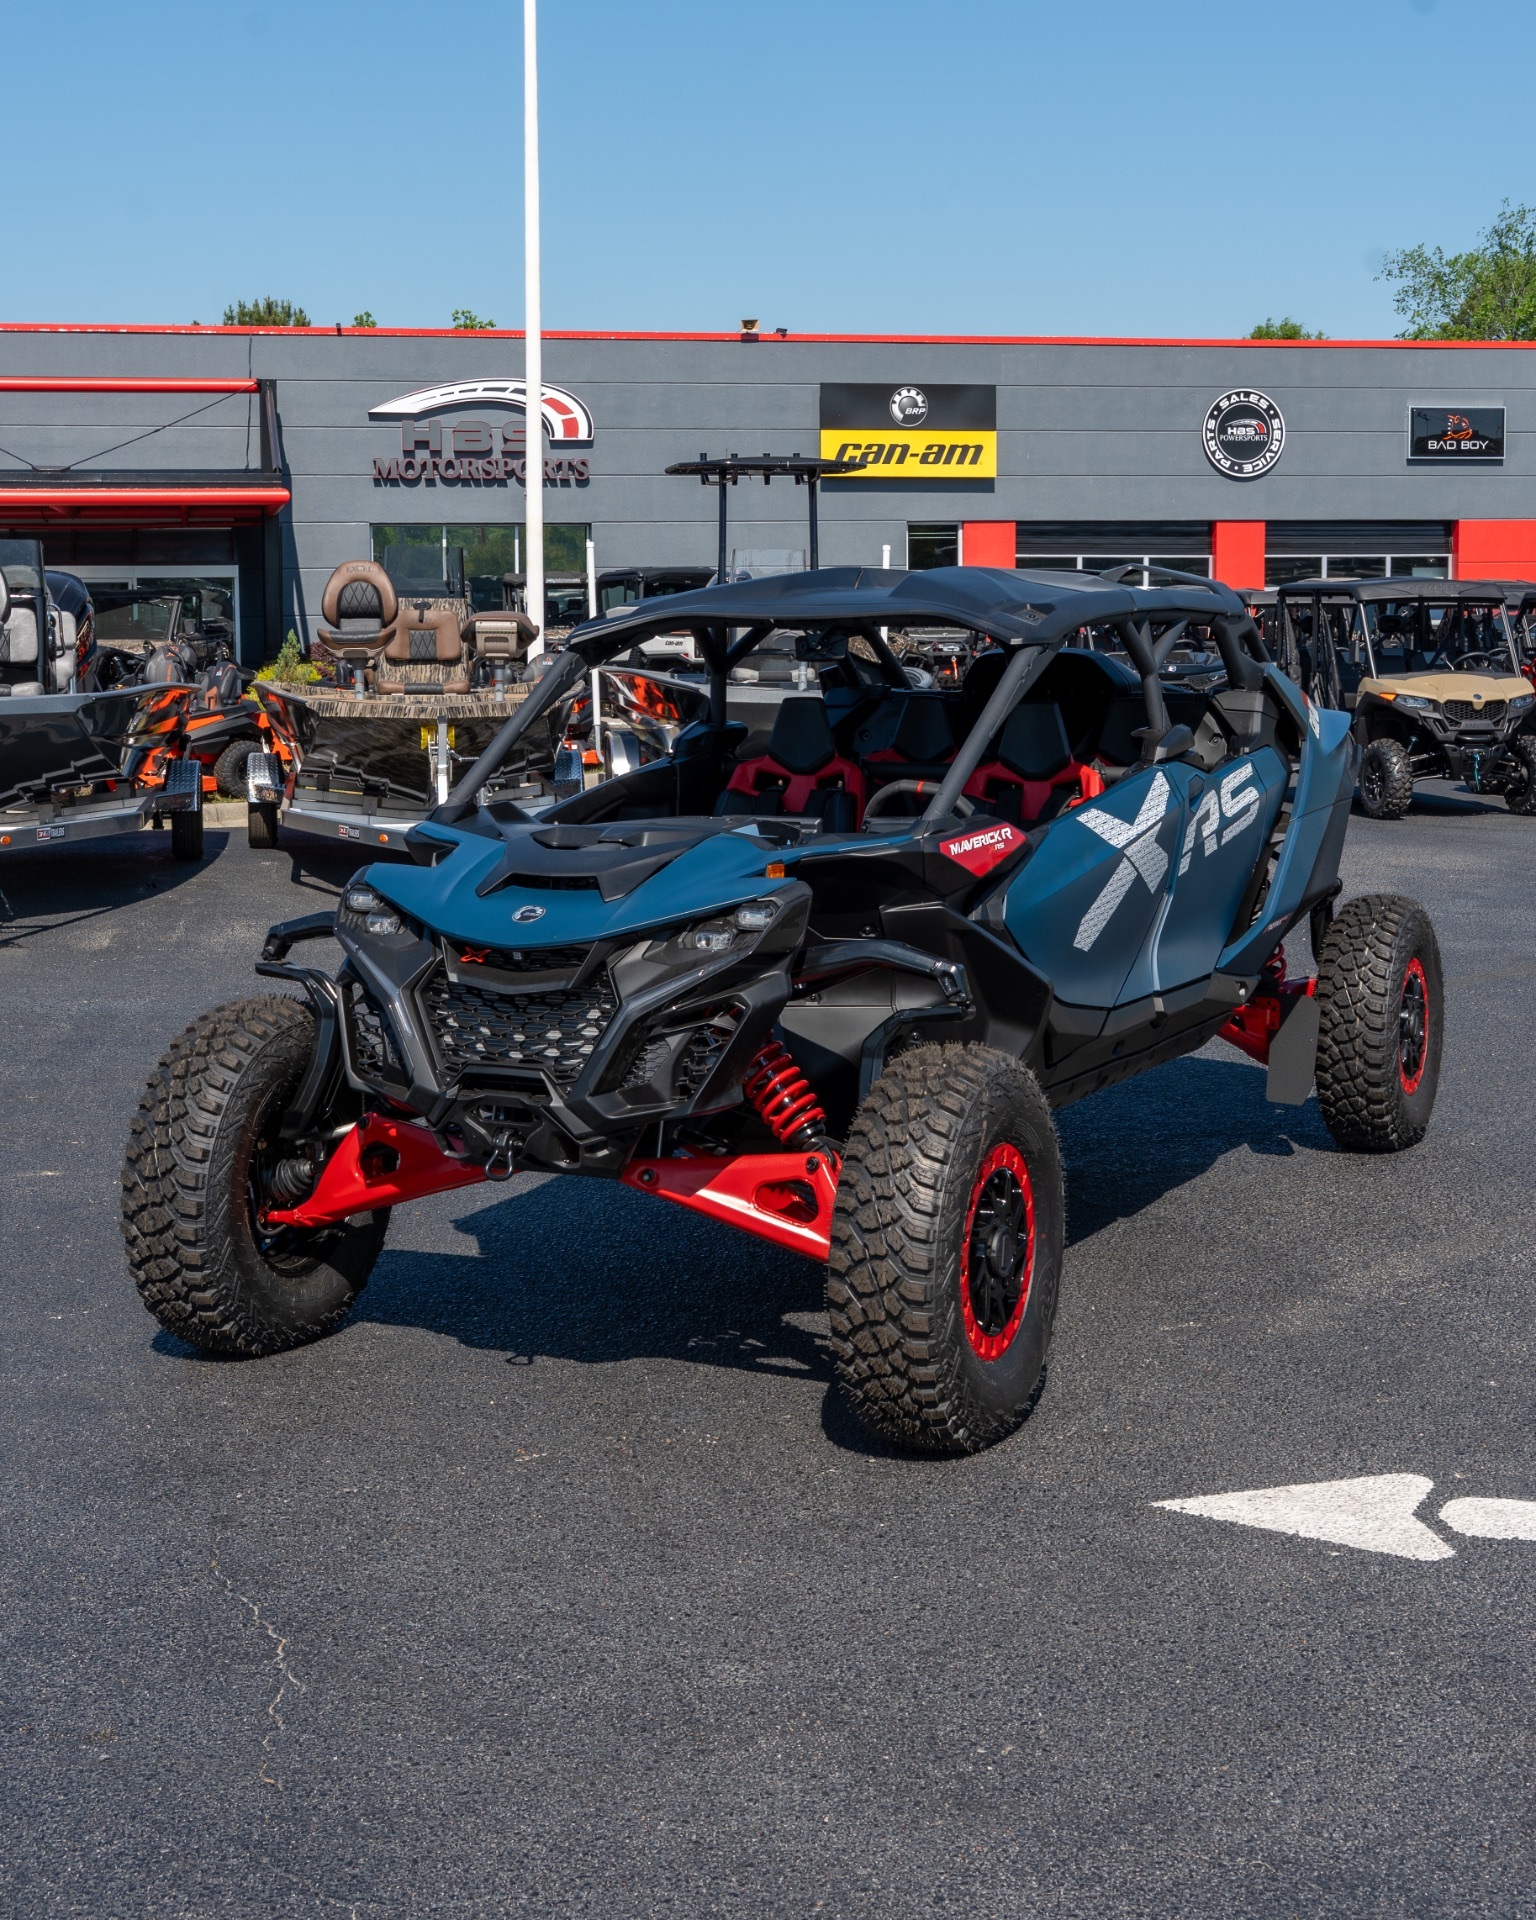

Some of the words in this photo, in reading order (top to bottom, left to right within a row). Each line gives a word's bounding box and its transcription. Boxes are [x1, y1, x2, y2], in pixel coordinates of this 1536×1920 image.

[1219, 392, 1270, 410] SALES
[904, 406, 927, 416] BRP
[401, 419, 528, 452] HBS
[1219, 434, 1268, 442] POWERSPORTS
[1227, 426, 1256, 435] HBS
[1206, 418, 1232, 469] PARTS
[1241, 418, 1282, 473] SERVICE
[1427, 440, 1457, 450] BAD
[1460, 440, 1490, 450] BOY
[834, 443, 984, 465] can-am
[346, 565, 374, 573] EXCEL
[948, 829, 1002, 856] MAVERICK
[1000, 827, 1013, 840] R
